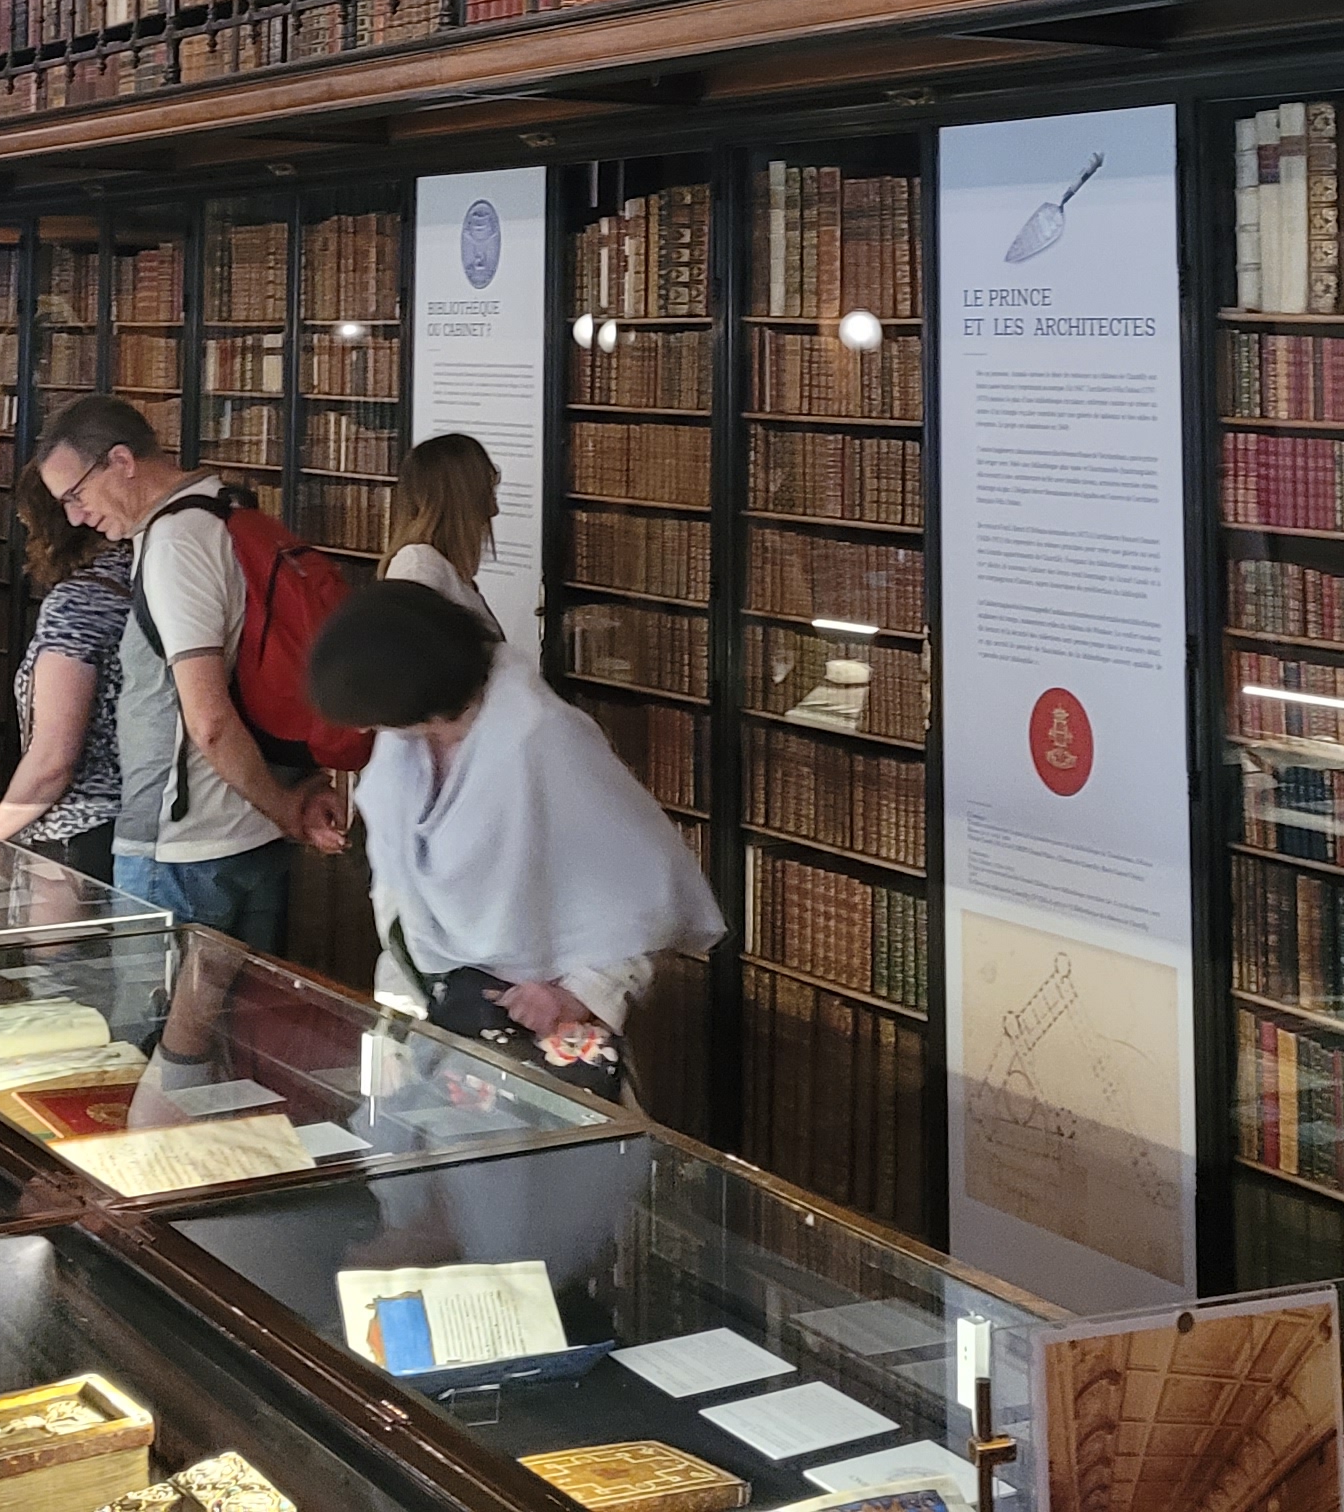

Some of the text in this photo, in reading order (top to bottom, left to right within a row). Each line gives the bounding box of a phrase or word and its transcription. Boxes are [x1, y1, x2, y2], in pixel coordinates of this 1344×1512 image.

[964, 289, 1051, 307] LE PRINCE
[964, 318, 1155, 336] ET LES ARCHITECTES
